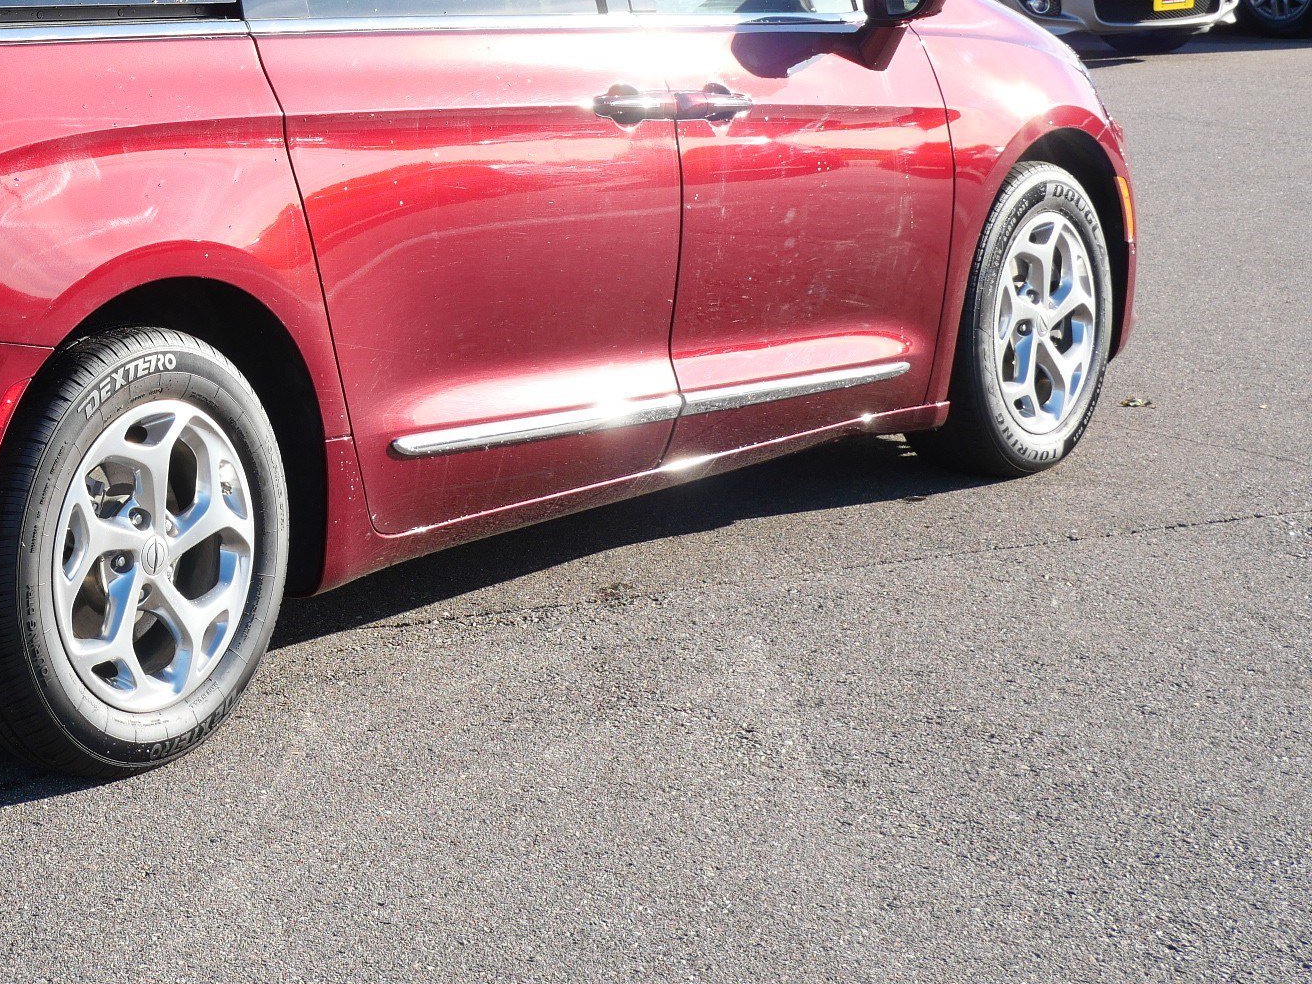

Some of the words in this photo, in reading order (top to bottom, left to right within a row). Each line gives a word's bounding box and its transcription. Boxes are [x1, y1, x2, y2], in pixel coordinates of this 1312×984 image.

[1052, 184, 1111, 278] DOUGLA
[77, 353, 177, 420] DEXTERO
[995, 413, 1058, 461] TOURING
[27, 620, 52, 687] TOURING
